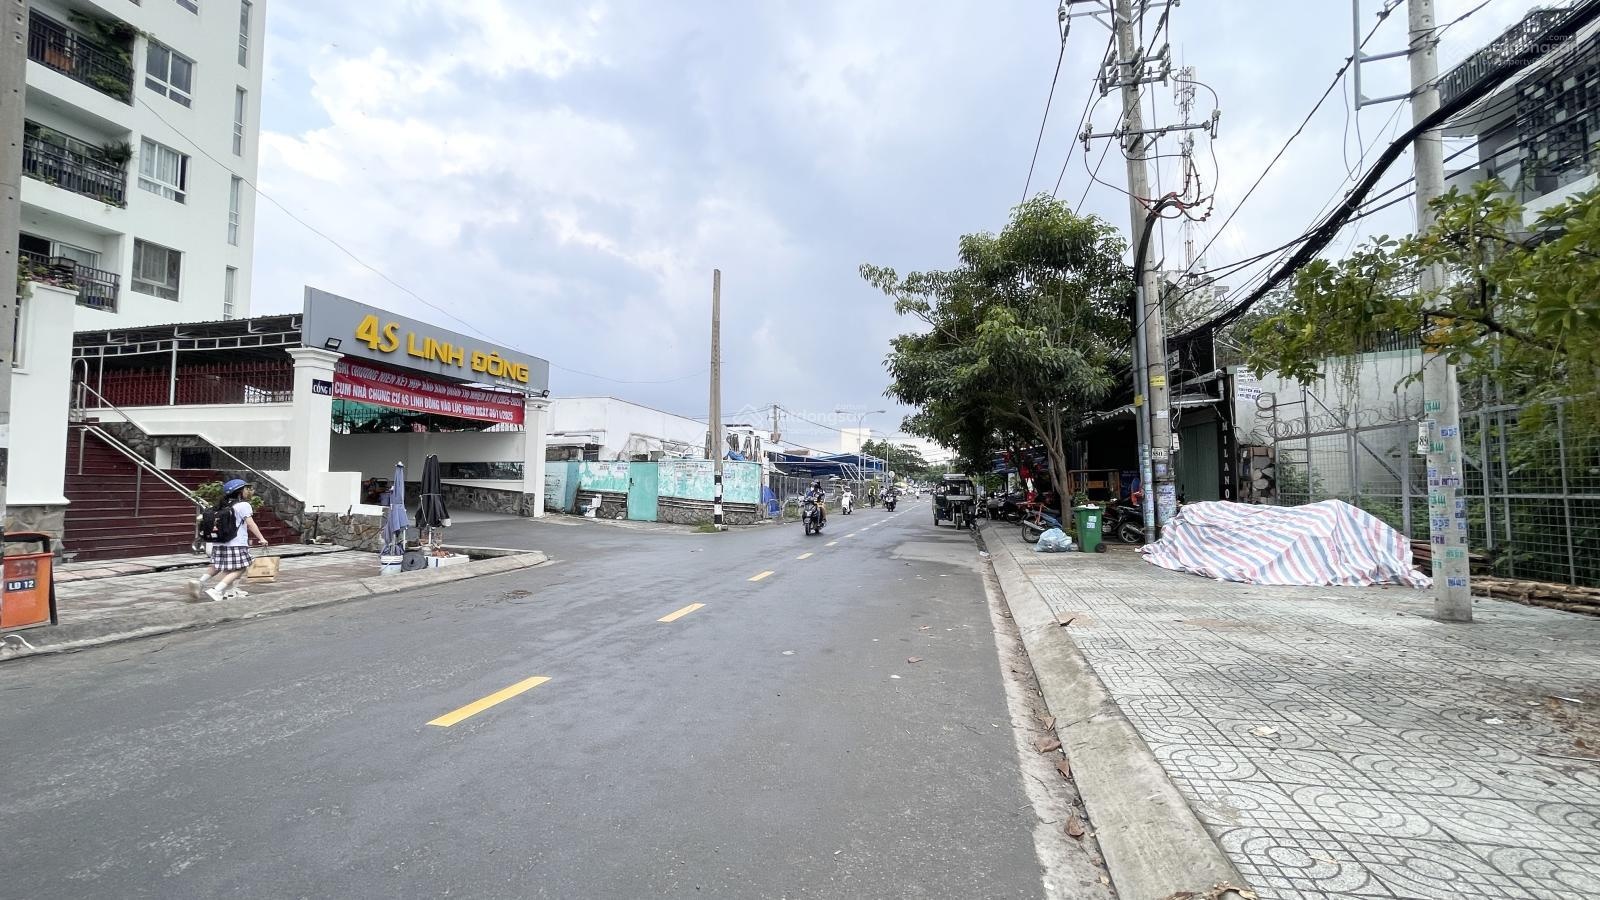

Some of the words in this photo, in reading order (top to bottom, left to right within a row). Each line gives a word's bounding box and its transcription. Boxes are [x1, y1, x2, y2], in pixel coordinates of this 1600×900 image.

[355, 314, 400, 353] 4S
[407, 333, 465, 367] LINH
[471, 351, 529, 383] ĐÔNG
[335, 382, 352, 398] CỤM
[353, 384, 367, 399] NHÀ
[368, 388, 390, 403] CHUNG
[391, 391, 400, 404] CƯ
[401, 394, 409, 406] 4S
[410, 395, 423, 408] LINH
[1222, 421, 1230, 499] MILANO
[24, 580, 34, 589] 12
